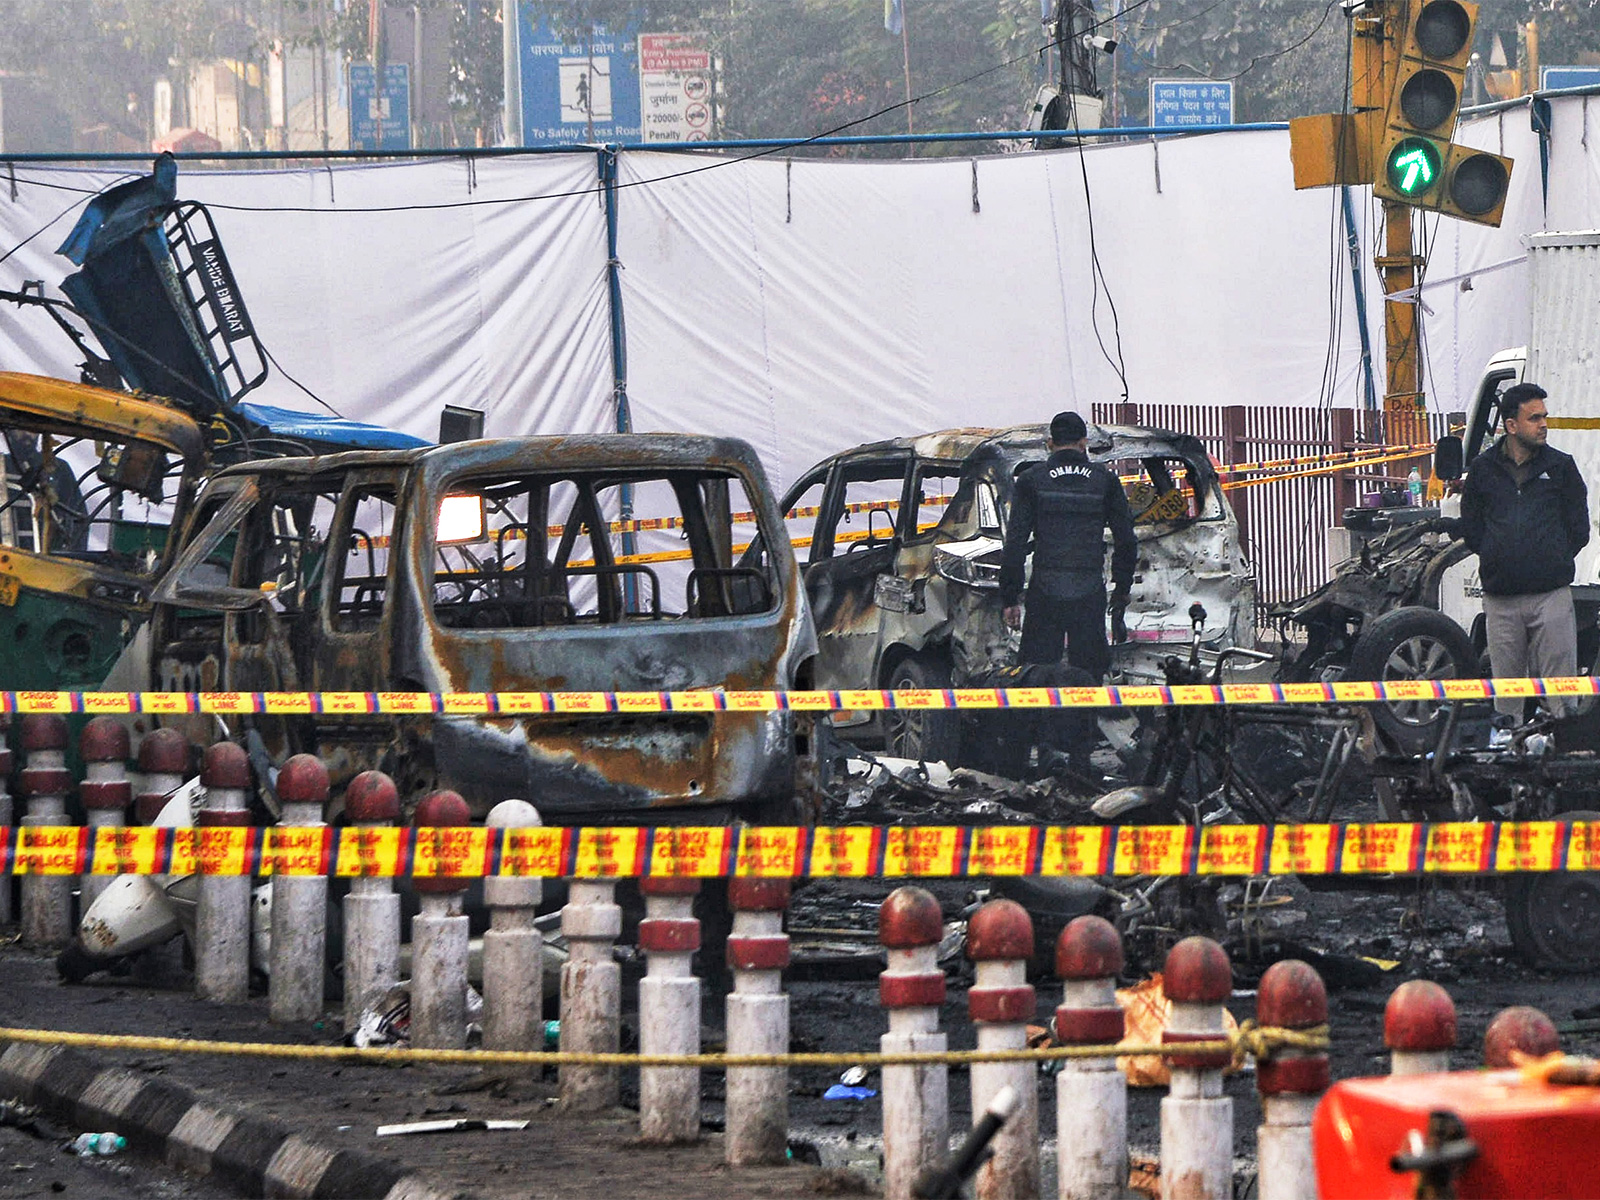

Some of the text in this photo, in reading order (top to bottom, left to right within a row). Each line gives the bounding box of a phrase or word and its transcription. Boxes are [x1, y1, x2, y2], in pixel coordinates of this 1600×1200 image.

[656, 58, 669, 68] AM
[649, 91, 678, 107] जुर्माना
[532, 129, 545, 139] To
[547, 127, 579, 139] Safely
[582, 127, 613, 137] Coss
[649, 130, 680, 141] Penalty
[203, 246, 244, 332] VANDE BHARAT
[1285, 688, 1320, 696] POLICE
[1445, 684, 1481, 692] POLICE
[21, 691, 59, 700] CROSS
[203, 692, 241, 701] CROSS
[382, 692, 418, 701] CROSS
[789, 696, 827, 704] POLICE
[957, 694, 993, 702] POLICE
[1071, 695, 1095, 703] LINE
[1122, 690, 1158, 699] POLICE
[1235, 692, 1259, 700] LINE
[30, 701, 56, 709] LINE
[86, 698, 127, 706] POLICE
[212, 702, 239, 710] LINE
[566, 701, 591, 709] LINE
[737, 700, 761, 708] LINE
[905, 698, 931, 706] LINE
[175, 830, 232, 843] DO NOT
[416, 830, 473, 843] DO NOT
[654, 831, 709, 843] DO NOT
[888, 830, 942, 843] DO NOT
[1118, 830, 1172, 842] DO NOT
[1345, 827, 1399, 839] DO NOT
[24, 833, 70, 847] DELHI
[268, 835, 313, 848] DELHI
[509, 835, 552, 849] DELHI
[745, 835, 787, 849] DELHI
[178, 845, 228, 858] CROSS
[420, 846, 470, 858] CROSS
[658, 846, 706, 858] CROSS
[892, 845, 938, 857] CROSS
[1122, 844, 1169, 856] CROSS
[1349, 841, 1396, 853] CROSS
[16, 854, 74, 868] POLICE
[261, 856, 317, 869] POLICE
[503, 856, 556, 868] POLICE
[739, 855, 792, 869] POLICE
[970, 854, 1022, 867] POLICE
[1199, 853, 1250, 866] POLICE
[1357, 856, 1387, 868] LINE
[1426, 850, 1476, 863] POLICE
[185, 861, 221, 874] LINE
[428, 861, 463, 874] LINE
[665, 860, 699, 873] LINE
[899, 859, 931, 872] LINE
[1130, 858, 1160, 871] LINE
